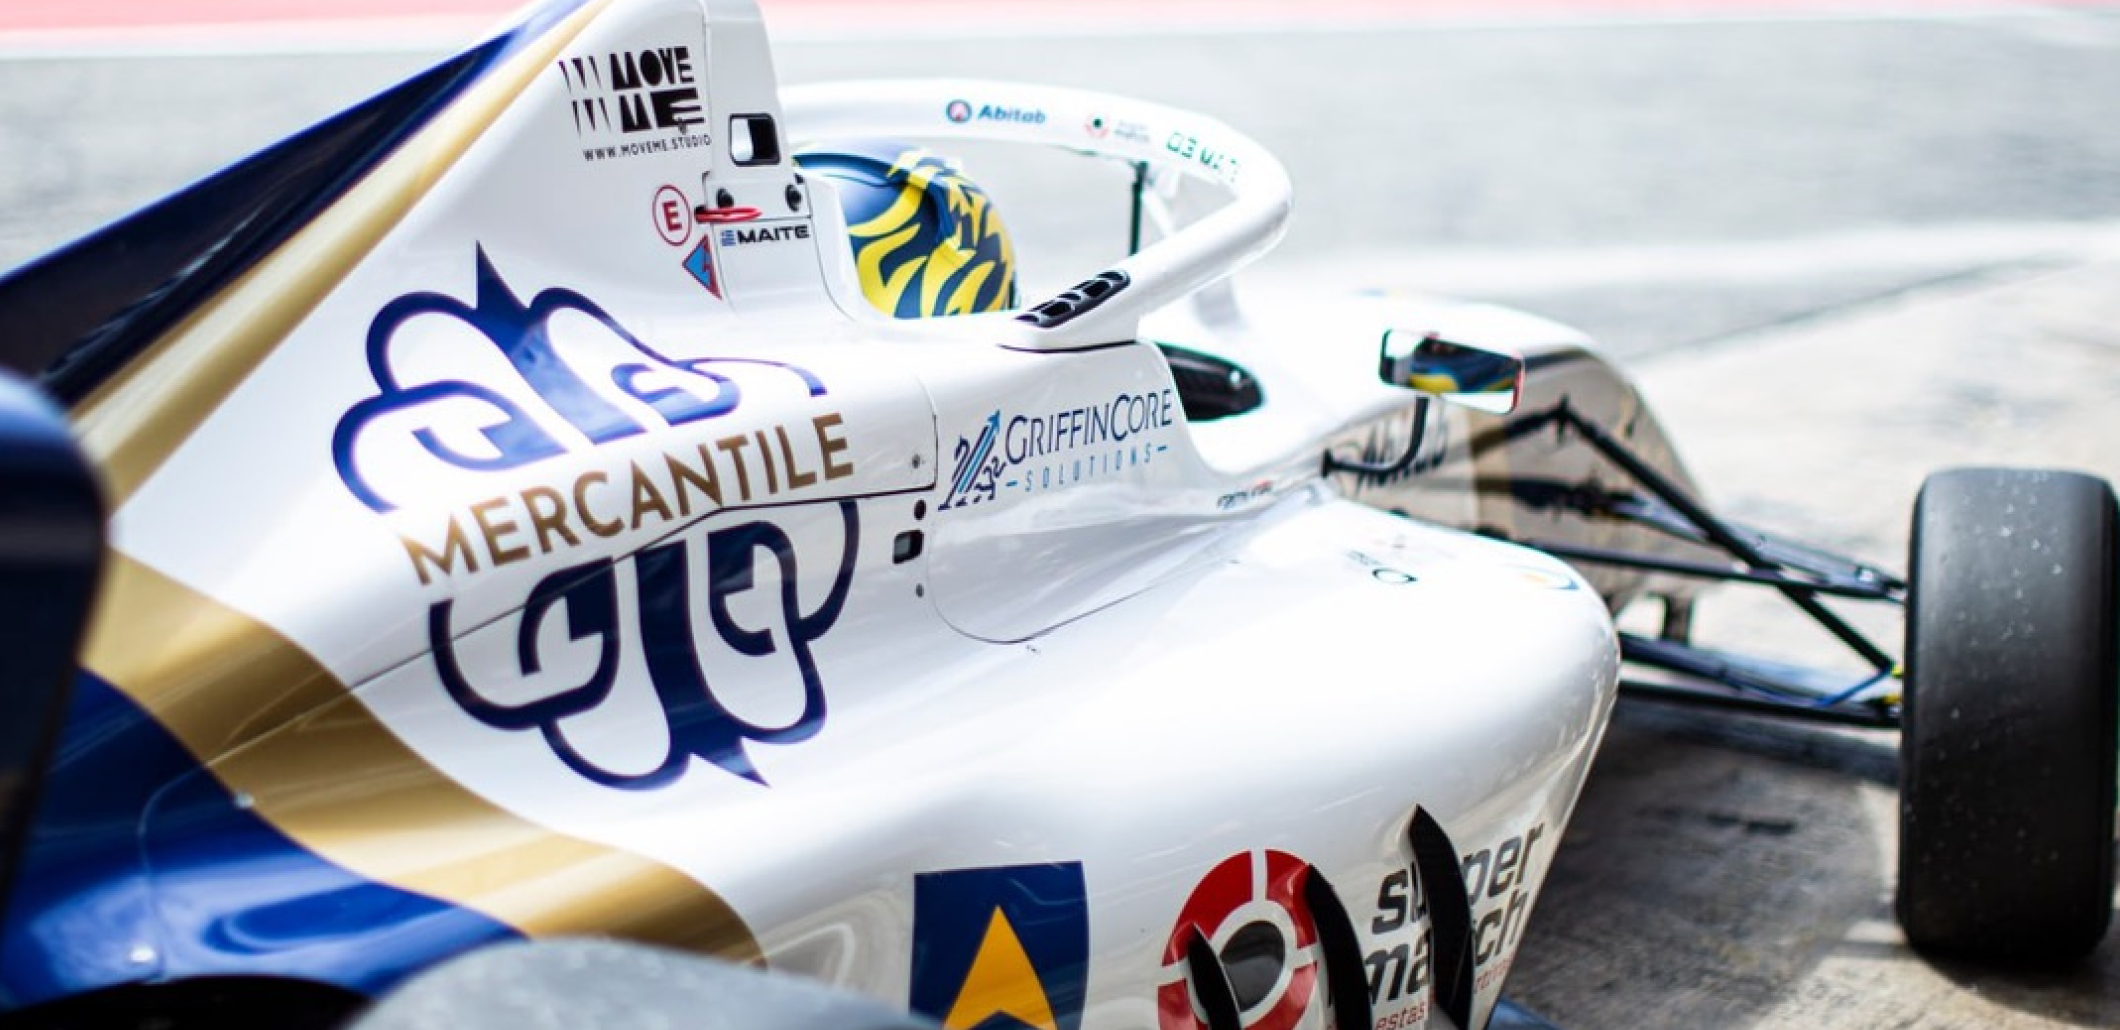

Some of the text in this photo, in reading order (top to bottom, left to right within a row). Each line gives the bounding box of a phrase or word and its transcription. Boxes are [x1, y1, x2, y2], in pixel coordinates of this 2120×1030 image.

[608, 46, 695, 91] MOVE
[618, 87, 705, 133] ME
[977, 104, 1046, 124] Abitab
[583, 134, 712, 161] WWW.MOVEME.STUDIO
[662, 200, 683, 231] E
[1024, 442, 1152, 492] SOLUTIONS
[400, 412, 854, 585] MERCANTILE
[1328, 888, 1528, 1006] mach
